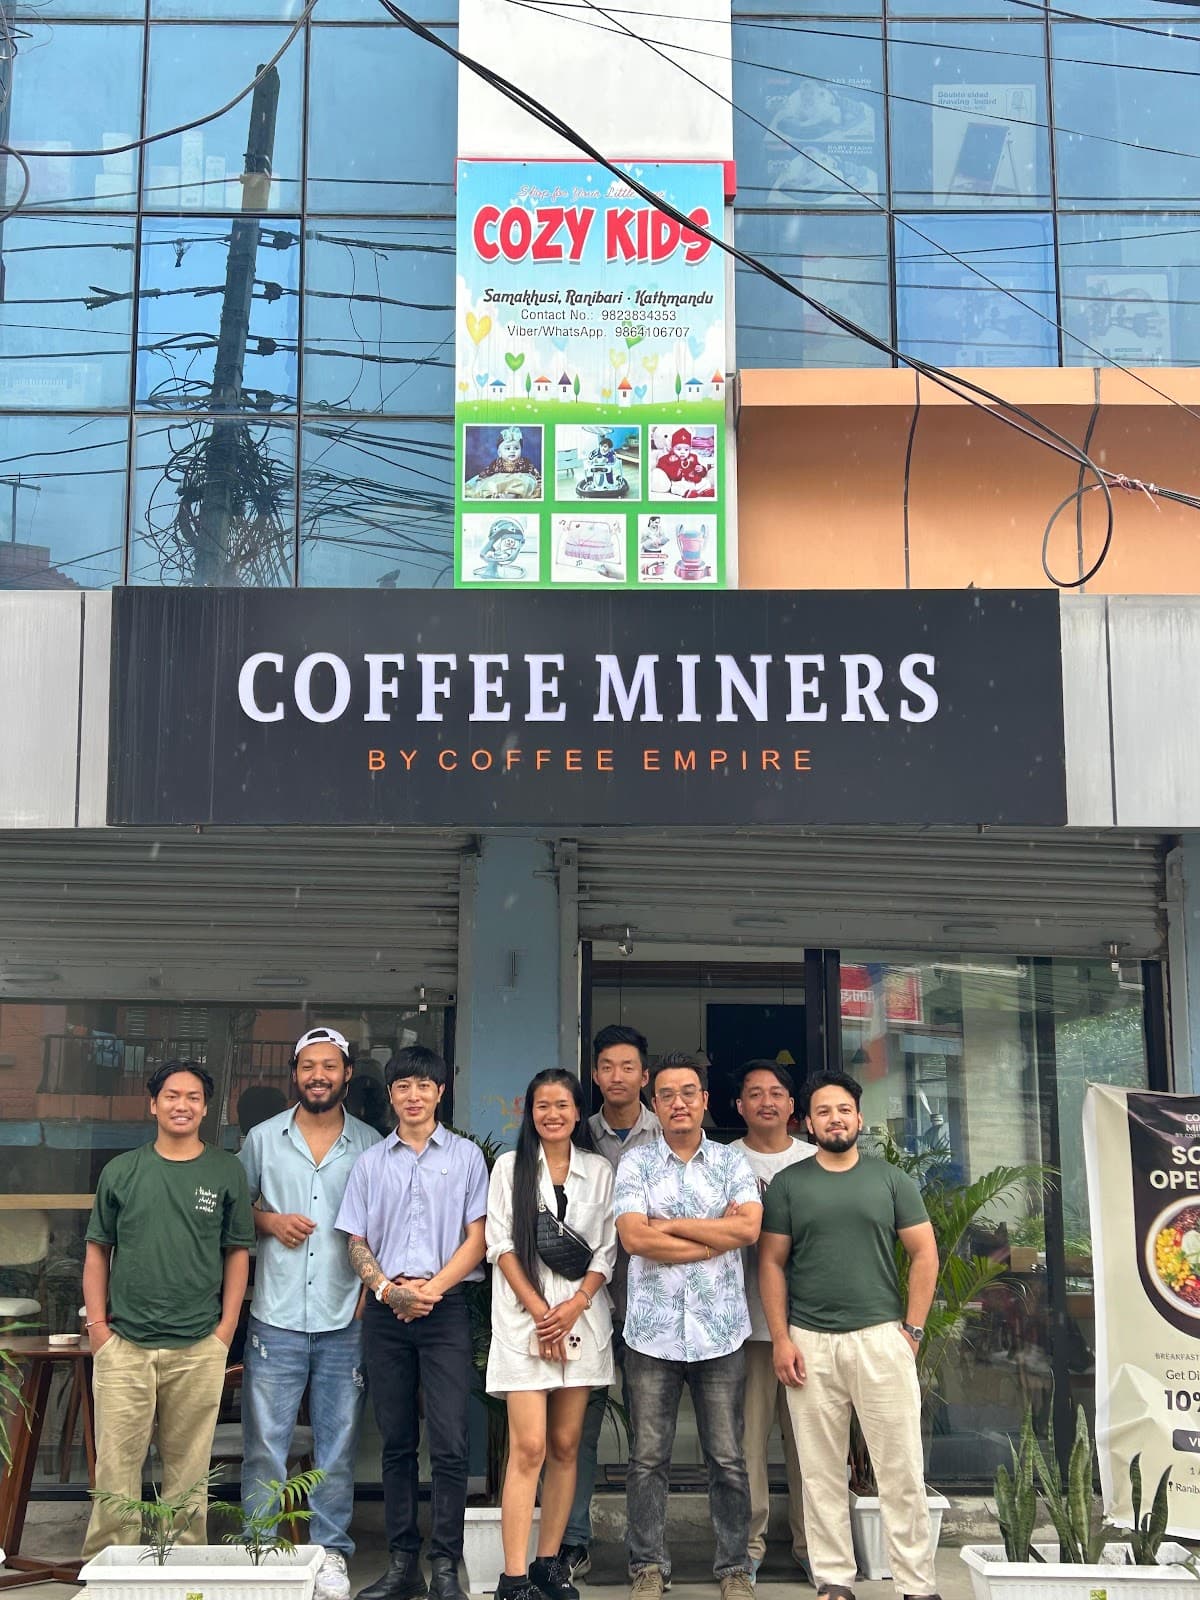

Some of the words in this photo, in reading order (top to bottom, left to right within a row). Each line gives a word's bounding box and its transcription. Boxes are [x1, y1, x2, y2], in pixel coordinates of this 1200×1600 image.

[473, 205, 595, 263] COZY
[606, 206, 712, 264] KIDS
[483, 288, 562, 306] Samakhusi,
[565, 289, 623, 306] Ranibari
[634, 290, 714, 307] Kathmandu
[521, 309, 566, 321] Contact
[601, 310, 677, 321] 9823834353
[615, 326, 690, 338] 9864106707
[237, 651, 567, 723] COFFEE
[592, 652, 940, 723] MINERS
[368, 749, 418, 771] BY
[438, 749, 614, 771] COFFEE
[643, 749, 813, 771] EMPIRE
[1149, 1170, 1200, 1190] OPE
[1155, 1352, 1199, 1361] BREAKFAST
[1166, 1369, 1185, 1380] Get
